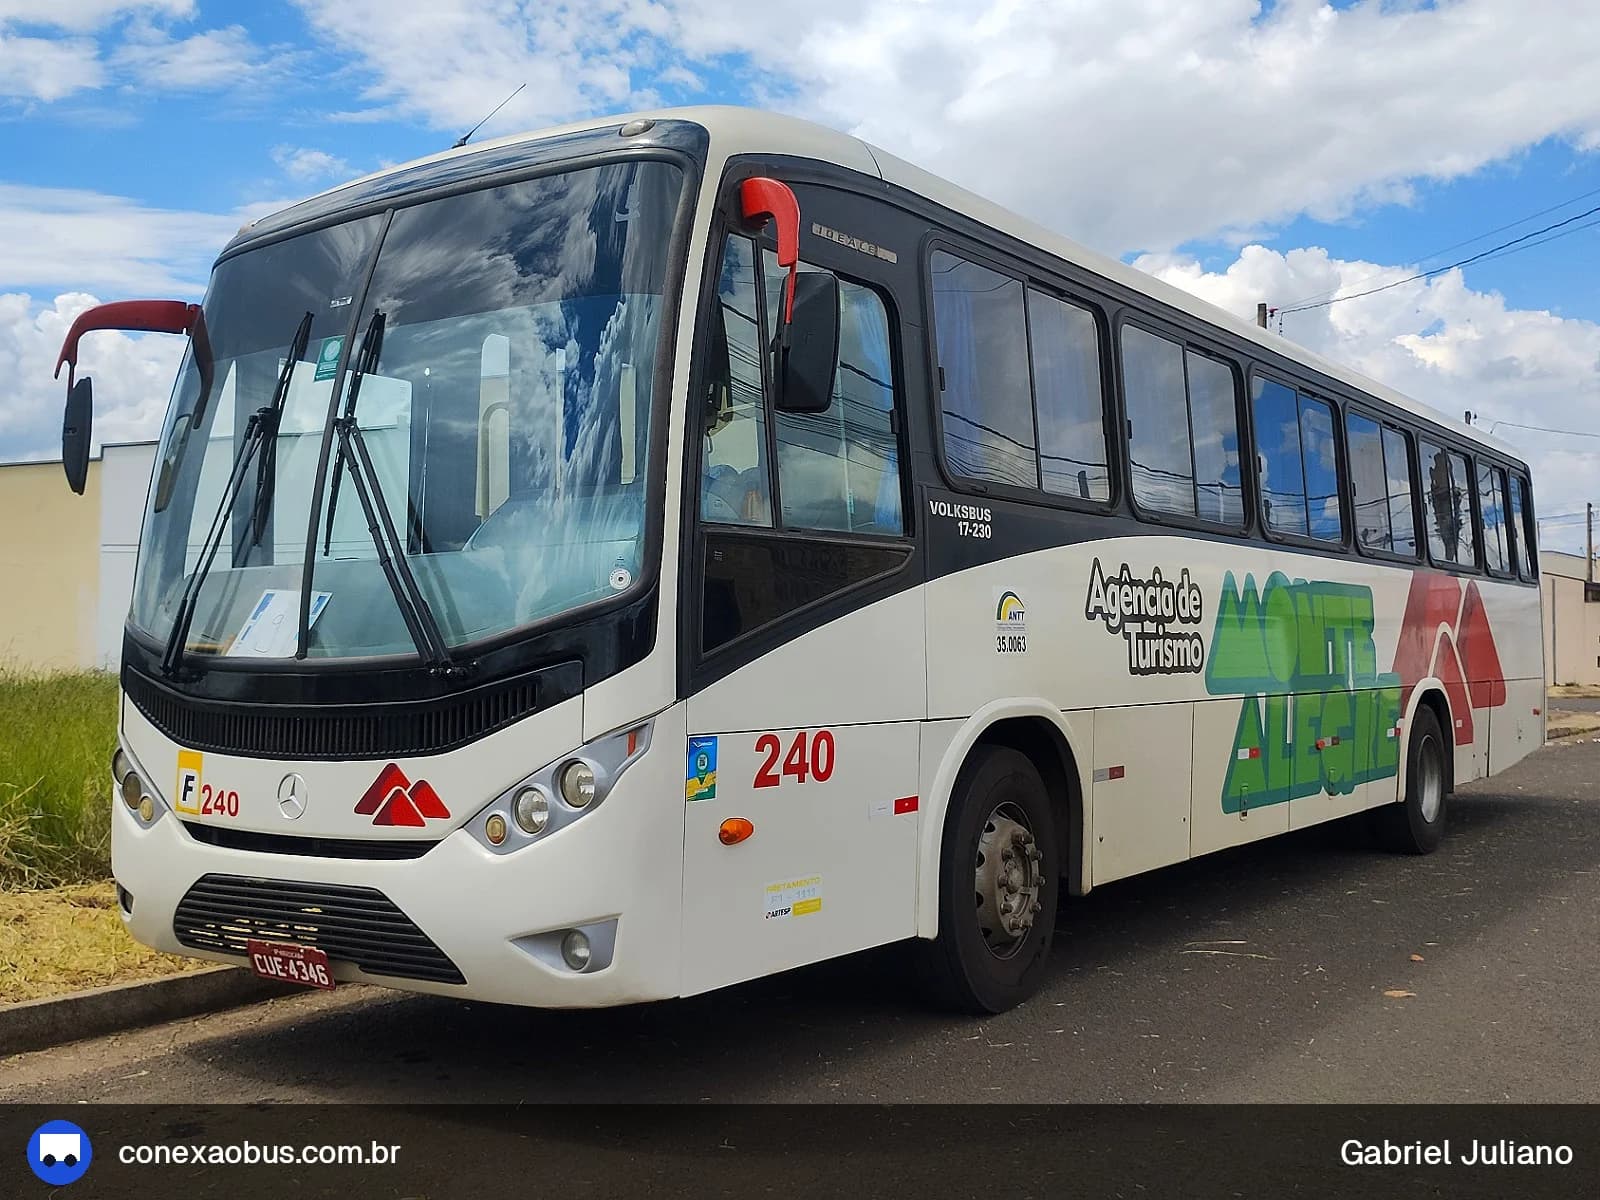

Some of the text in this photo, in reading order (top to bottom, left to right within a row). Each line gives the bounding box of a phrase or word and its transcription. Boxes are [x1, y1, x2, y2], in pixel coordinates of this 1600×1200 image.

[929, 500, 991, 521] VOLKSBUS
[958, 521, 991, 539] 17-230
[1009, 610, 1025, 621] ANTT
[1086, 557, 1202, 633] Agência de
[1122, 621, 1204, 675] Turismo
[1206, 570, 1376, 694] MONTE
[753, 730, 834, 788] 240
[1222, 674, 1402, 814] ALEGRE
[182, 774, 195, 801] F
[202, 784, 239, 816] 240
